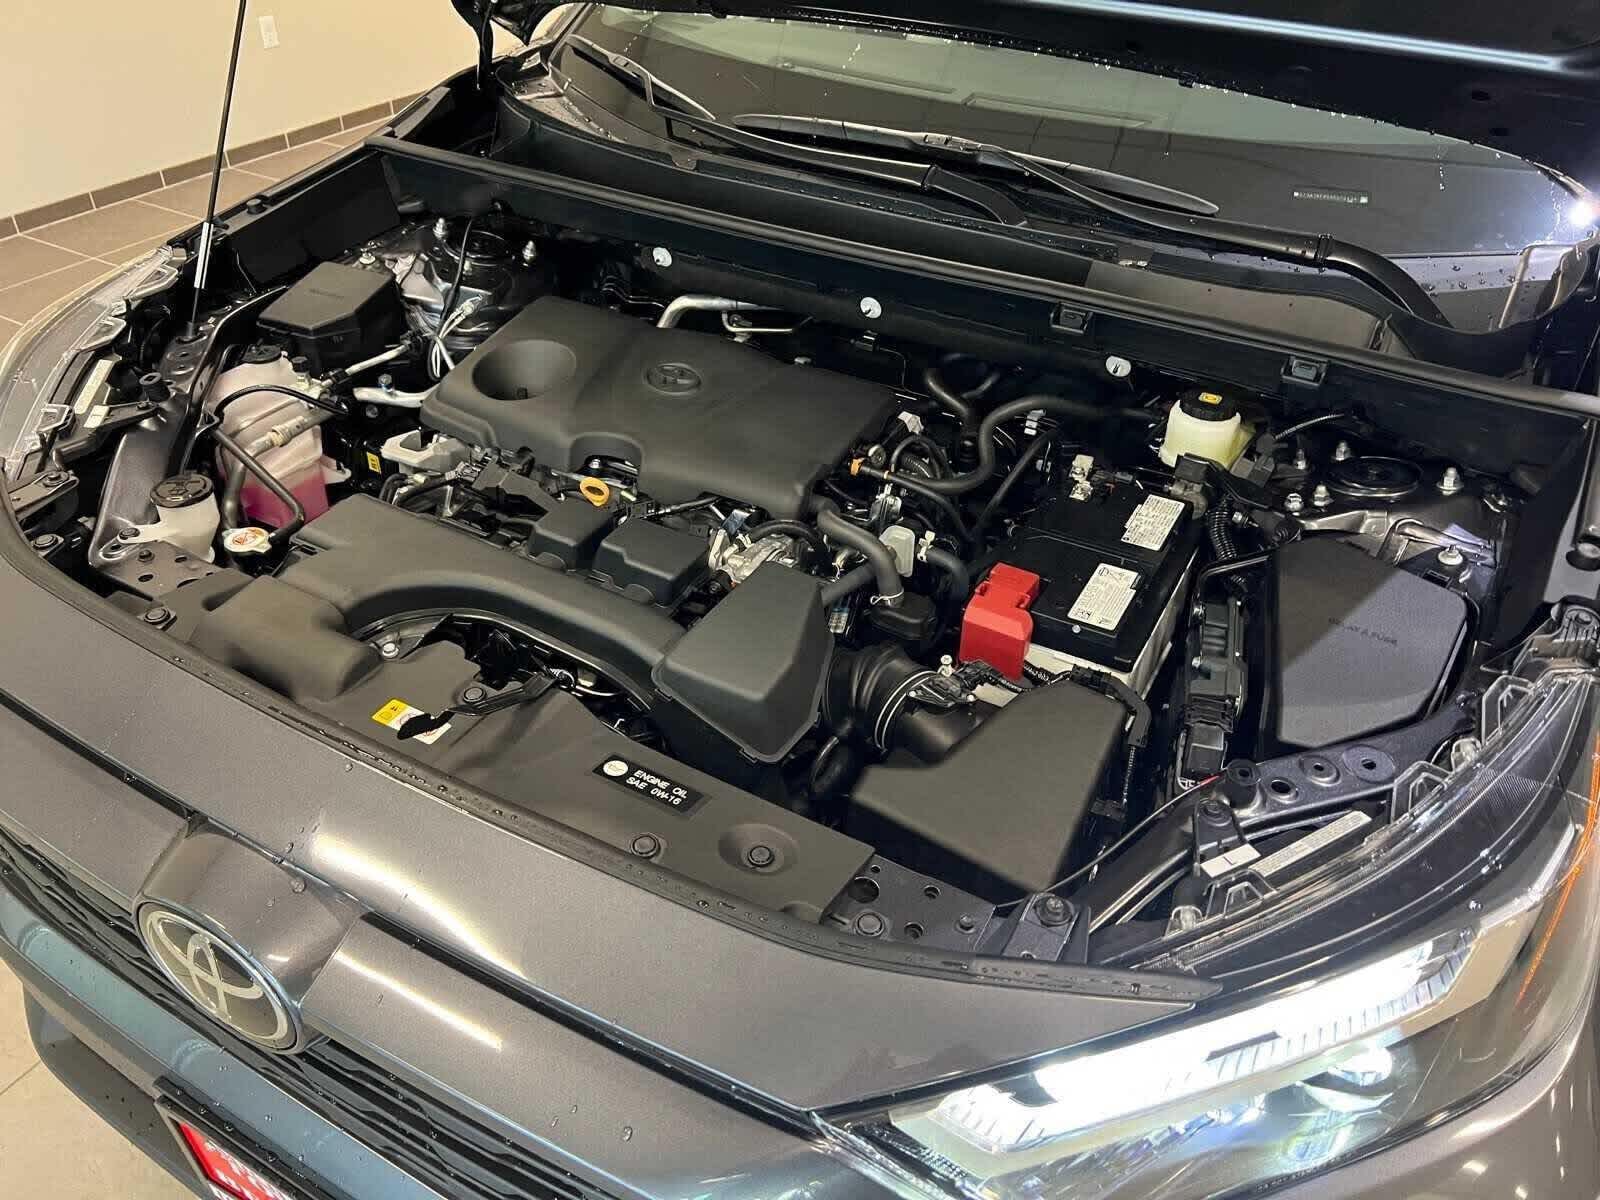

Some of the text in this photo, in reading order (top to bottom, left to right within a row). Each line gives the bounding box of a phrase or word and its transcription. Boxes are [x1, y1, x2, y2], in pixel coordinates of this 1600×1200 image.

[626, 777, 682, 804] SAE 0W-16
[634, 770, 688, 799] ENGINE OIL
